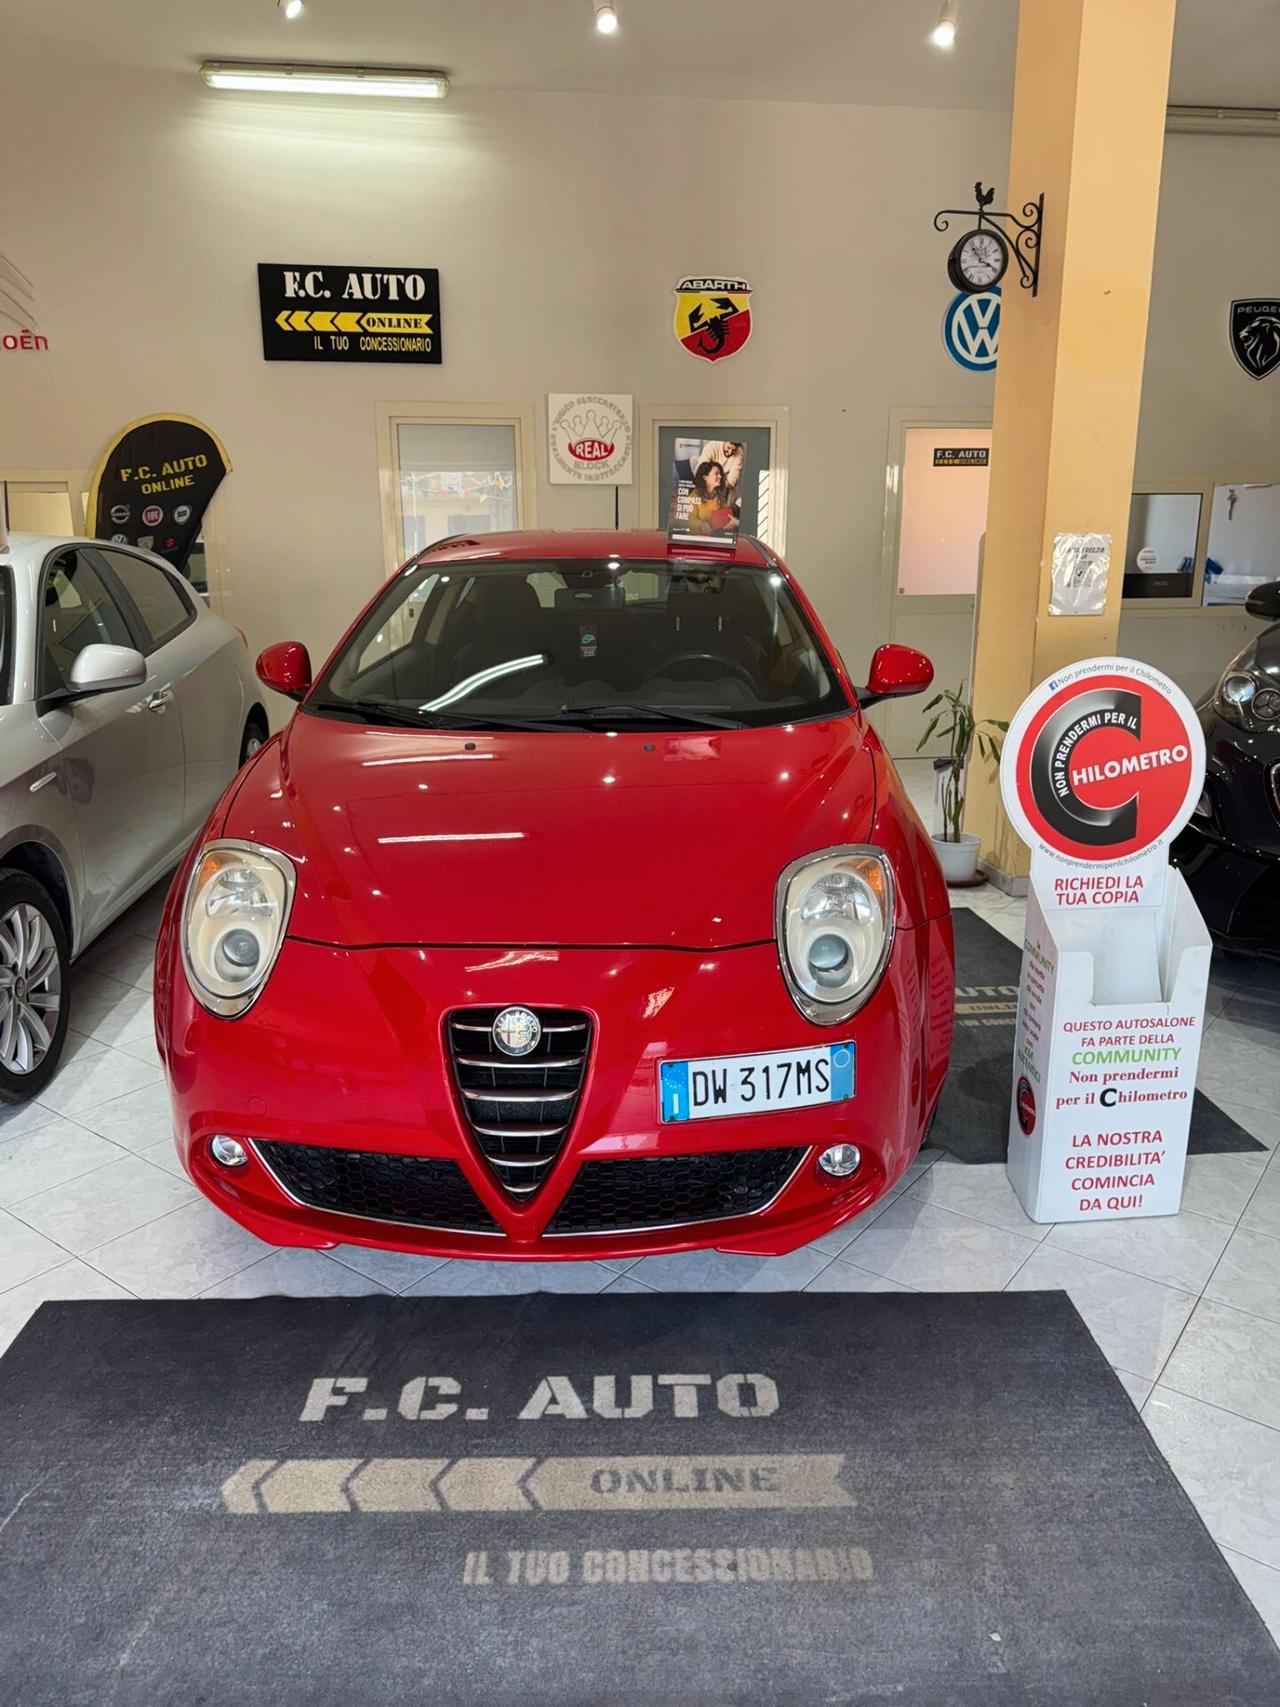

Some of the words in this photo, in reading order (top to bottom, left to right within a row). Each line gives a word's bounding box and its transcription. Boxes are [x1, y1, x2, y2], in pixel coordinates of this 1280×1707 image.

[284, 271, 331, 298] F.C.
[342, 273, 426, 300] AUTO
[681, 280, 746, 290] ABARTH
[1237, 305, 1280, 313] PEUGE
[366, 317, 423, 329] ONLINE
[314, 336, 324, 350] IL
[330, 336, 349, 350] TUO
[360, 337, 432, 352] CONCESSIONARIO
[575, 441, 609, 458] REAL
[936, 450, 955, 458] F.C.
[958, 450, 986, 458] AUTO
[120, 466, 157, 482] F.C.
[162, 454, 208, 476] AUTO
[574, 461, 610, 470] BLOCK
[141, 474, 195, 495] ONLINE
[1057, 671, 1074, 685] Non
[1075, 664, 1114, 677] prendermi
[1115, 664, 1128, 673] per
[1136, 668, 1172, 695] Chilometro
[1104, 712, 1126, 726] PER
[1127, 716, 1138, 730] IL
[1055, 714, 1102, 768] PRENDERMI
[1072, 744, 1189, 786] HILOMETRO
[1054, 772, 1070, 798] NON
[1055, 875, 1120, 891] RICHIEDI
[1125, 875, 1144, 889] LA
[1056, 892, 1087, 906] TUA
[1092, 891, 1139, 905] COPIA
[1063, 1020, 1112, 1033] QUESTO
[1115, 1016, 1196, 1030] AUTOSALONE
[1081, 1037, 1095, 1048] FA
[1099, 1035, 1135, 1047] PARTE
[1138, 1033, 1174, 1045] DELLA
[1071, 1047, 1182, 1066] COMMUNITY
[692, 1068, 728, 1106] DW
[740, 1058, 830, 1102] 317MS
[1069, 1070, 1098, 1083] Non
[1103, 1067, 1179, 1086] prendermi
[1055, 1096, 1081, 1110] per
[1085, 1092, 1095, 1105] il
[1099, 1087, 1188, 1108] Chilometro
[1072, 1134, 1092, 1148] LA
[1097, 1130, 1163, 1147] NOSTRA
[1071, 1173, 1155, 1191] COMINCIA
[1079, 1198, 1102, 1211] DA
[1107, 1194, 1143, 1211] QUI!
[300, 1376, 489, 1421] F.C.
[517, 1373, 780, 1420] AUTO
[590, 1467, 779, 1494] ONLINE
[463, 1551, 493, 1585] IL
[507, 1550, 569, 1585] TUO
[583, 1548, 874, 1583] CONCESSIONARIO
